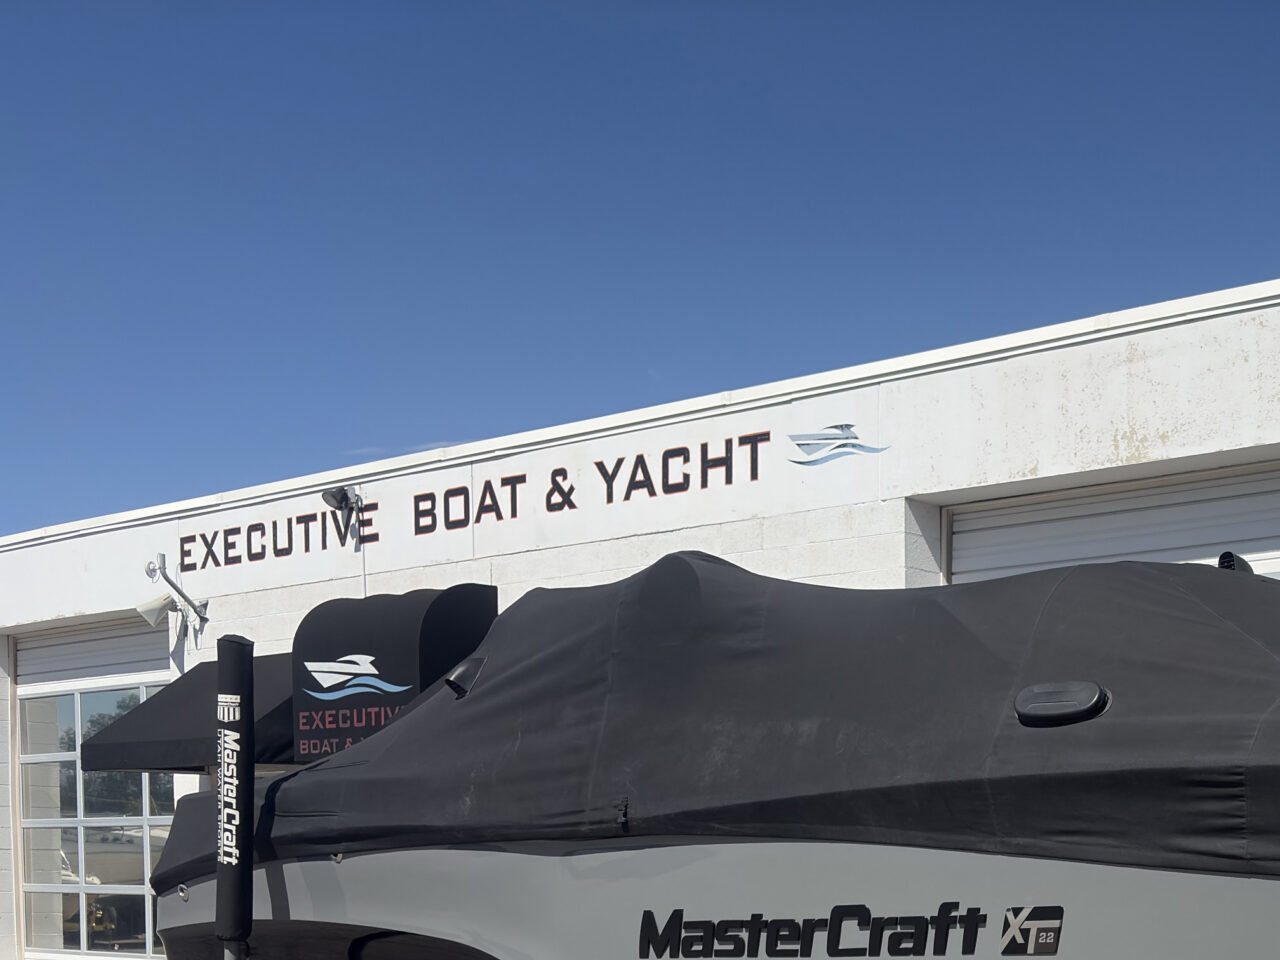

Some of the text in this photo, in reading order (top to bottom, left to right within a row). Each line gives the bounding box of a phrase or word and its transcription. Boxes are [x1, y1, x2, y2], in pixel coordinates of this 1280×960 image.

[179, 430, 771, 573] EXECUTIVE BOAT & YACHT
[299, 738, 339, 754] BOAT
[223, 729, 240, 865] MasterCraft
[638, 902, 988, 959] MasterCraft
